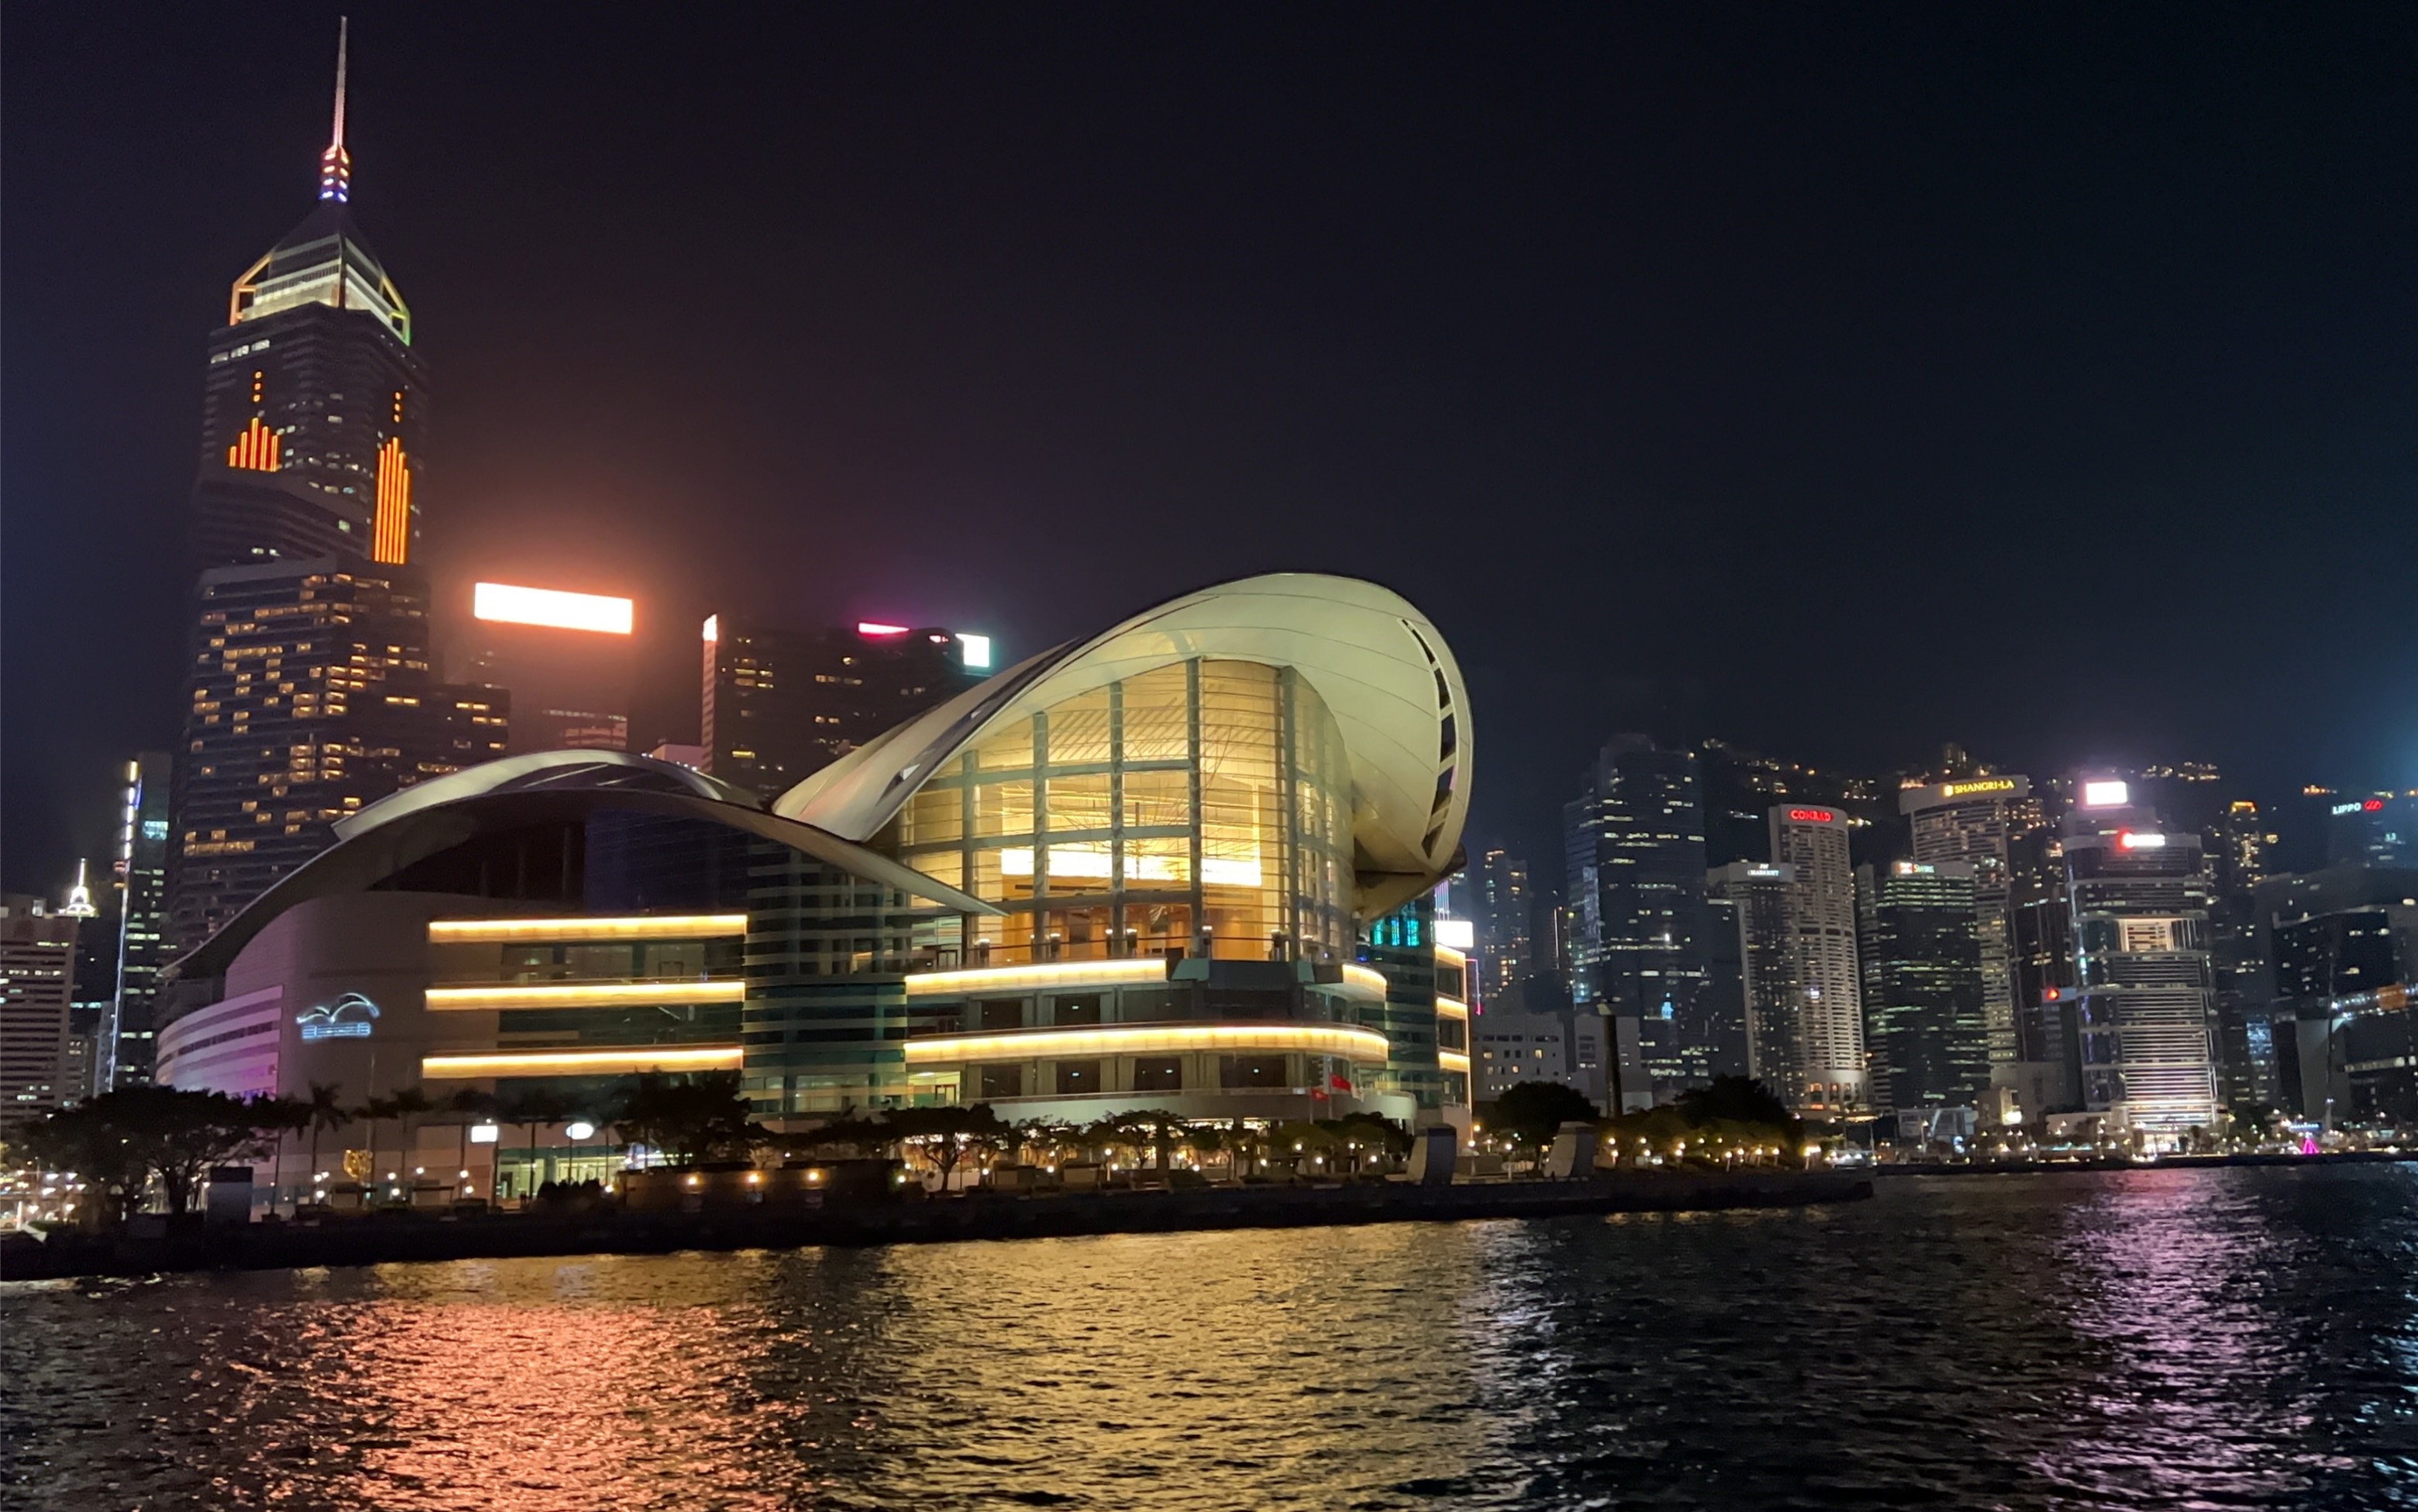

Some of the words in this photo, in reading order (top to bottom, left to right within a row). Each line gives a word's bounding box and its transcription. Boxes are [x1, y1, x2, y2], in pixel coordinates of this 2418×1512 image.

[1954, 779, 2015, 794] SHANGRI-LA
[2332, 802, 2362, 815] LIPPO
[1790, 809, 1832, 822] CONRAD
